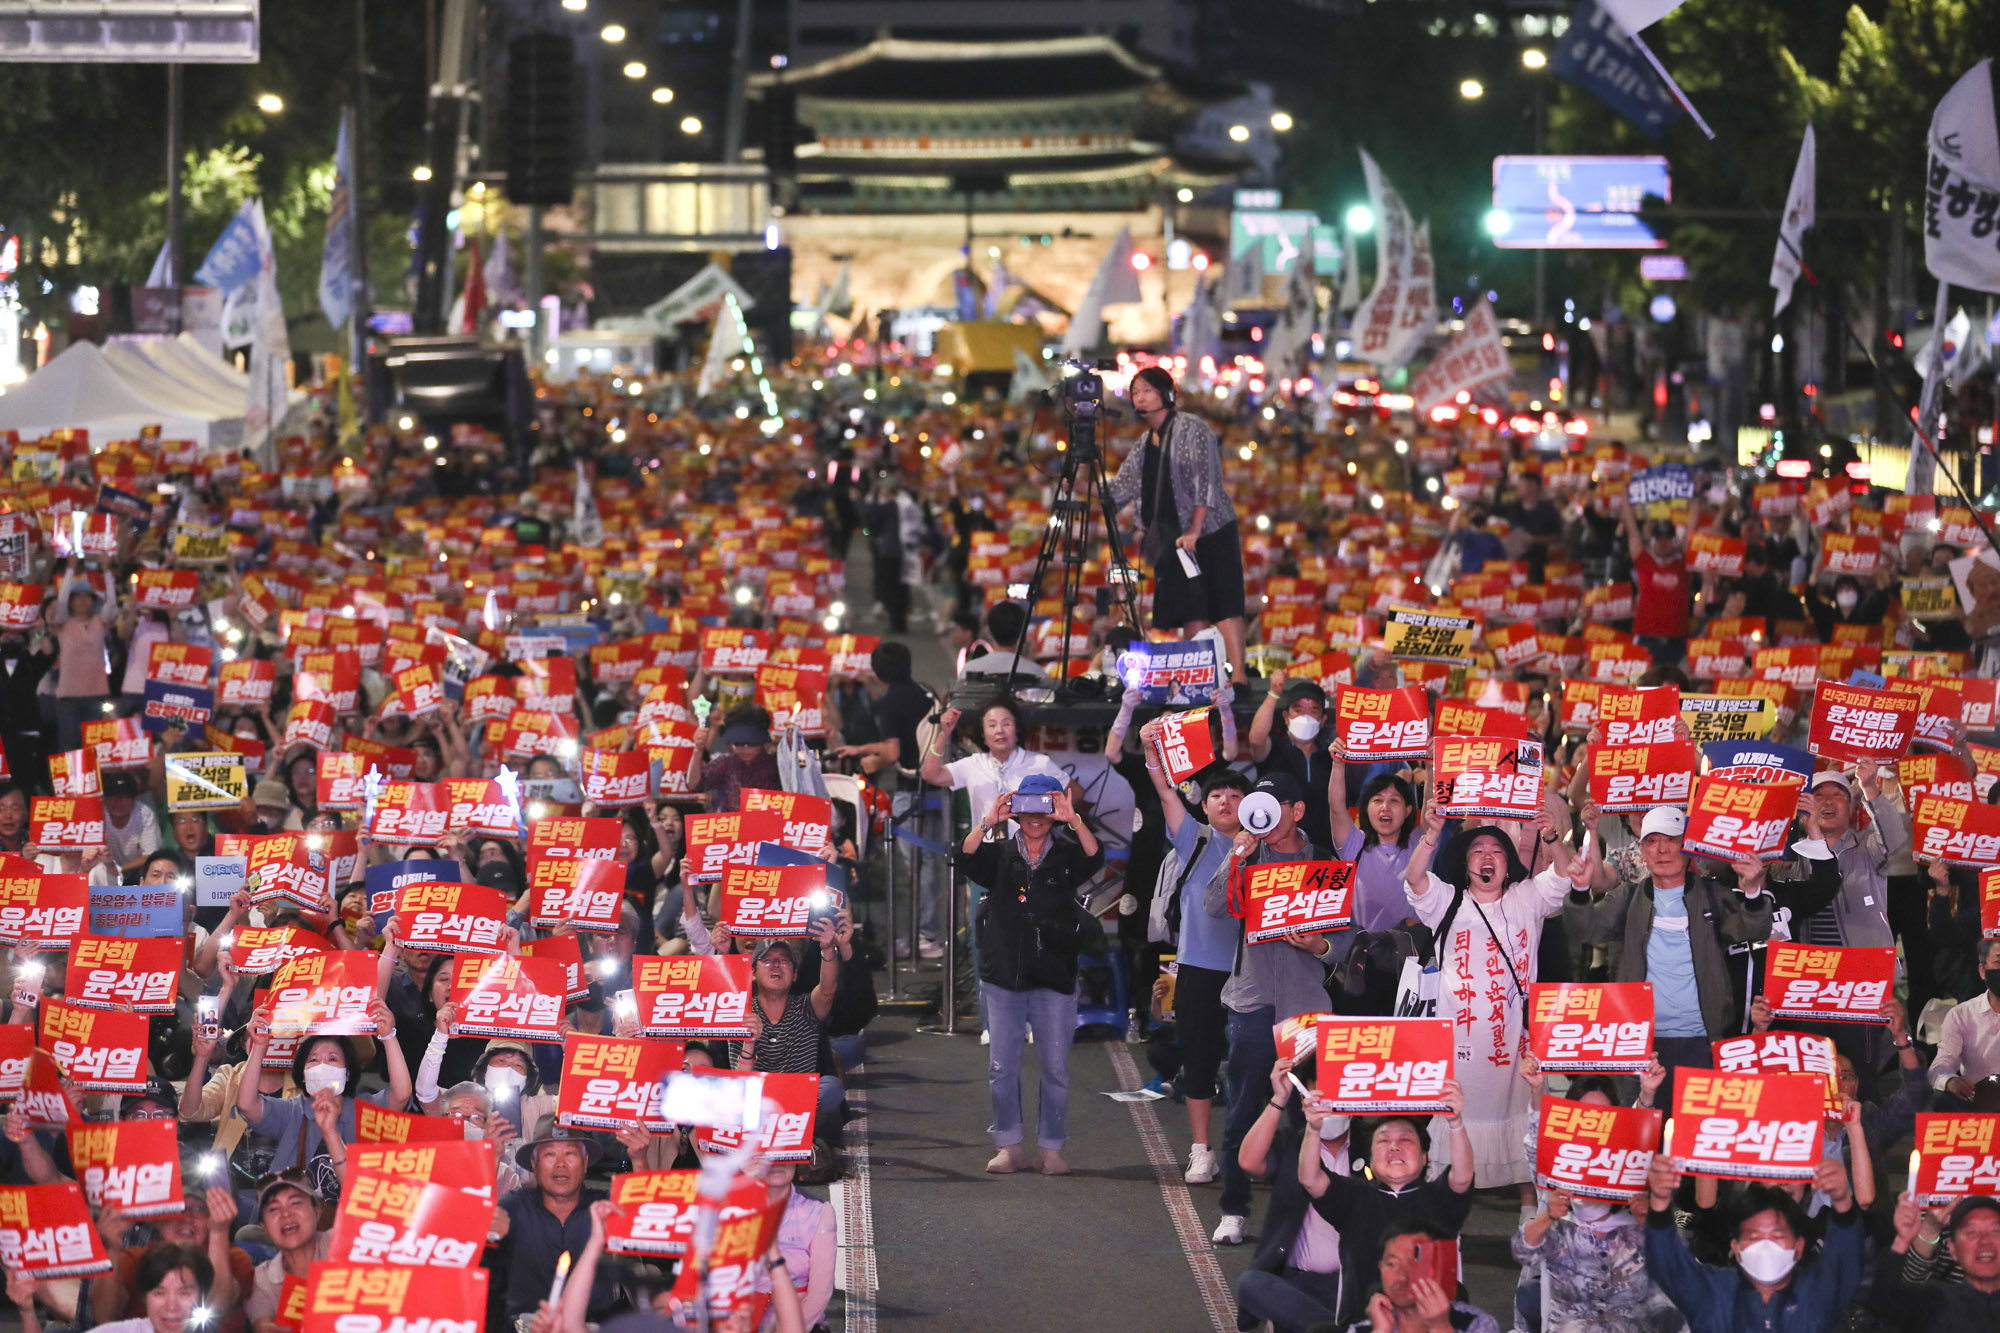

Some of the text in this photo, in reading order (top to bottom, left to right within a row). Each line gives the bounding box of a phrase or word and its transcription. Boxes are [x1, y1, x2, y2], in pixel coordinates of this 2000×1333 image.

[1340, 691, 1392, 720] 탄핵
[1600, 694, 1644, 720] 탄핵
[1681, 699, 1716, 711] 범국민
[1822, 688, 1917, 712] 민주파괴 검찰독재
[1347, 718, 1428, 750] 윤석열
[1437, 706, 1487, 736] 탄핵
[1607, 715, 1676, 746] 윤석열
[1693, 712, 1747, 731] 윤석열
[1826, 705, 1898, 731] 윤석열을
[1918, 712, 1954, 739] 석열
[1163, 720, 1194, 774] 석열
[1829, 725, 1904, 750] 타도하자!
[1441, 743, 1501, 772] 탄핵
[1595, 747, 1649, 775] 탄핵
[1732, 752, 1784, 767] 이제는
[1899, 757, 1937, 783] 탄핵
[448, 782, 488, 802] 탄핵
[586, 772, 648, 798] 윤석열
[1452, 772, 1539, 805] 윤석열
[1607, 771, 1691, 803] 윤석열
[1699, 783, 1768, 819] 탄핵
[34, 800, 75, 821] 탄핵
[376, 809, 448, 835] 윤석열
[450, 803, 515, 828] 윤석열
[746, 794, 795, 819] 탄핵
[1917, 798, 1968, 829] 탄핵
[40, 821, 104, 844] 윤석열
[532, 821, 586, 846] 탄핵
[691, 816, 741, 845] 탄핵
[783, 820, 828, 848] 석열
[1703, 815, 1790, 851] 윤석열
[1923, 827, 2000, 860] 윤석열
[250, 836, 297, 869] 탄핵
[258, 862, 326, 900] 윤석열
[534, 861, 582, 887] 탄핵
[727, 869, 781, 896] 탄핵
[1251, 865, 1307, 899] 탄핵
[400, 885, 461, 912] 탄핵
[541, 889, 619, 919] 윤석열
[735, 897, 811, 925] 윤석열
[1260, 888, 1347, 928] 윤석열
[0, 907, 84, 936] 윤석열
[237, 927, 296, 948] 탄핵
[410, 912, 501, 945] 윤석열
[74, 939, 138, 970] 탄핵
[245, 945, 322, 966] 윤석
[1772, 948, 1842, 980] 탄핵
[83, 970, 176, 1001] 윤석열
[274, 956, 326, 992] 탄핵
[456, 959, 521, 989] 탄핵
[639, 960, 702, 991] 탄핵
[1453, 929, 1477, 1037] 퇴진하라
[277, 987, 371, 1019] 윤석열
[465, 991, 563, 1025] 윤석열
[651, 991, 747, 1024] 윤석열
[1535, 989, 1602, 1021] 탄핵
[1781, 980, 1888, 1010] 윤석열
[43, 1004, 95, 1043] 탄핵
[1547, 1021, 1648, 1057] 윤석열
[52, 1040, 142, 1078] 윤석열
[1324, 1026, 1396, 1061] 탄핵
[1720, 1035, 1836, 1075] 윤석열
[570, 1043, 641, 1079] 탄핵
[1338, 1061, 1448, 1098] 윤석열
[1681, 1077, 1763, 1117] 탄핵
[360, 1108, 411, 1143] 탄핵
[1543, 1105, 1617, 1145] 탄핵
[1693, 1117, 1818, 1161] 윤석열
[1923, 1118, 1996, 1154] 탄핵
[73, 1127, 118, 1167] 탄핵
[358, 1148, 435, 1182] 탄핵
[1551, 1143, 1653, 1185] 윤석열
[1936, 1155, 2000, 1192] 윤석
[85, 1162, 173, 1207] 윤석열
[619, 1175, 699, 1204] 탄핵
[0, 1190, 29, 1229] 핵
[345, 1176, 427, 1228] 탄핵
[0, 1222, 93, 1267] 윤석열
[349, 1221, 477, 1268] 윤석열
[312, 1268, 412, 1314] 탄핵
